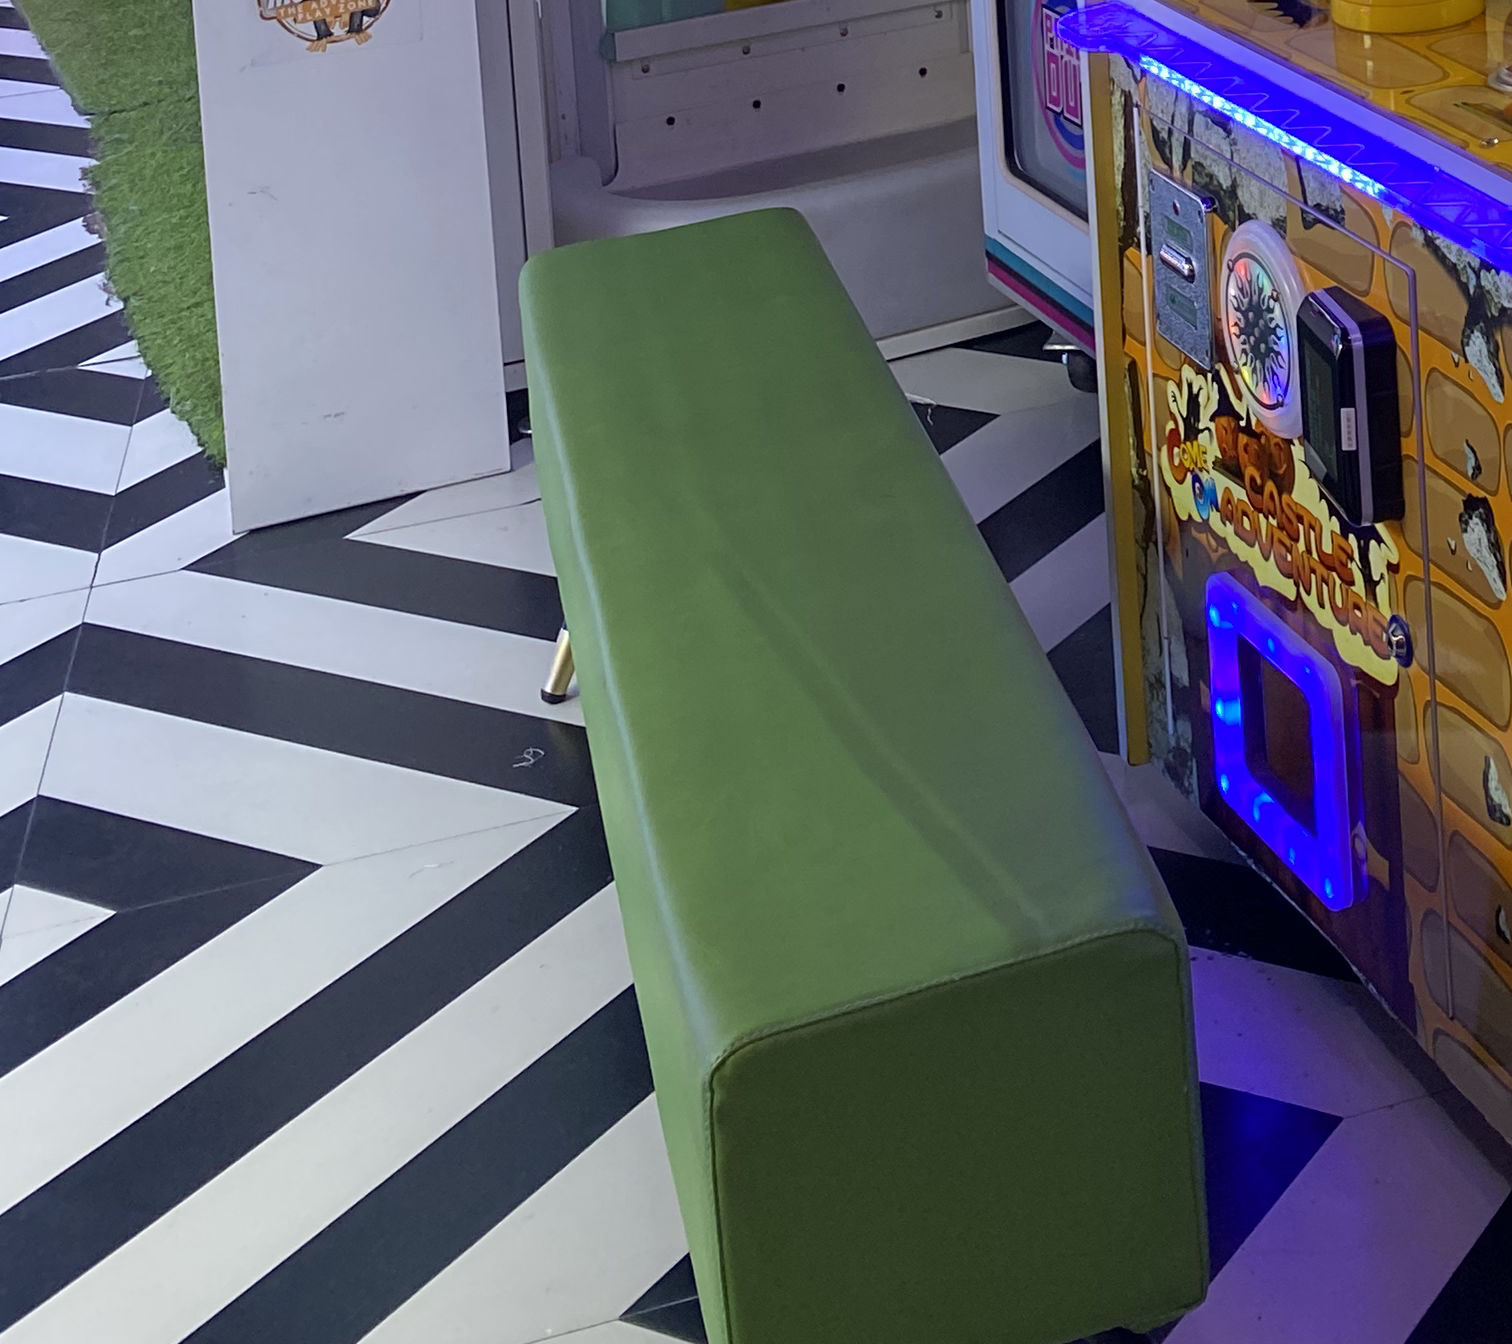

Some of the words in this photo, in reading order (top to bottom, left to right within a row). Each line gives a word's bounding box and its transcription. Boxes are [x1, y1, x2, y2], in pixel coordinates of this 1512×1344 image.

[279, 3, 304, 19] THE
[297, 5, 332, 22] PLAY
[1165, 424, 1210, 485] COME
[1191, 472, 1221, 522] ON
[1245, 473, 1357, 589] CASTLE
[1220, 486, 1393, 661] ADVENTURE
